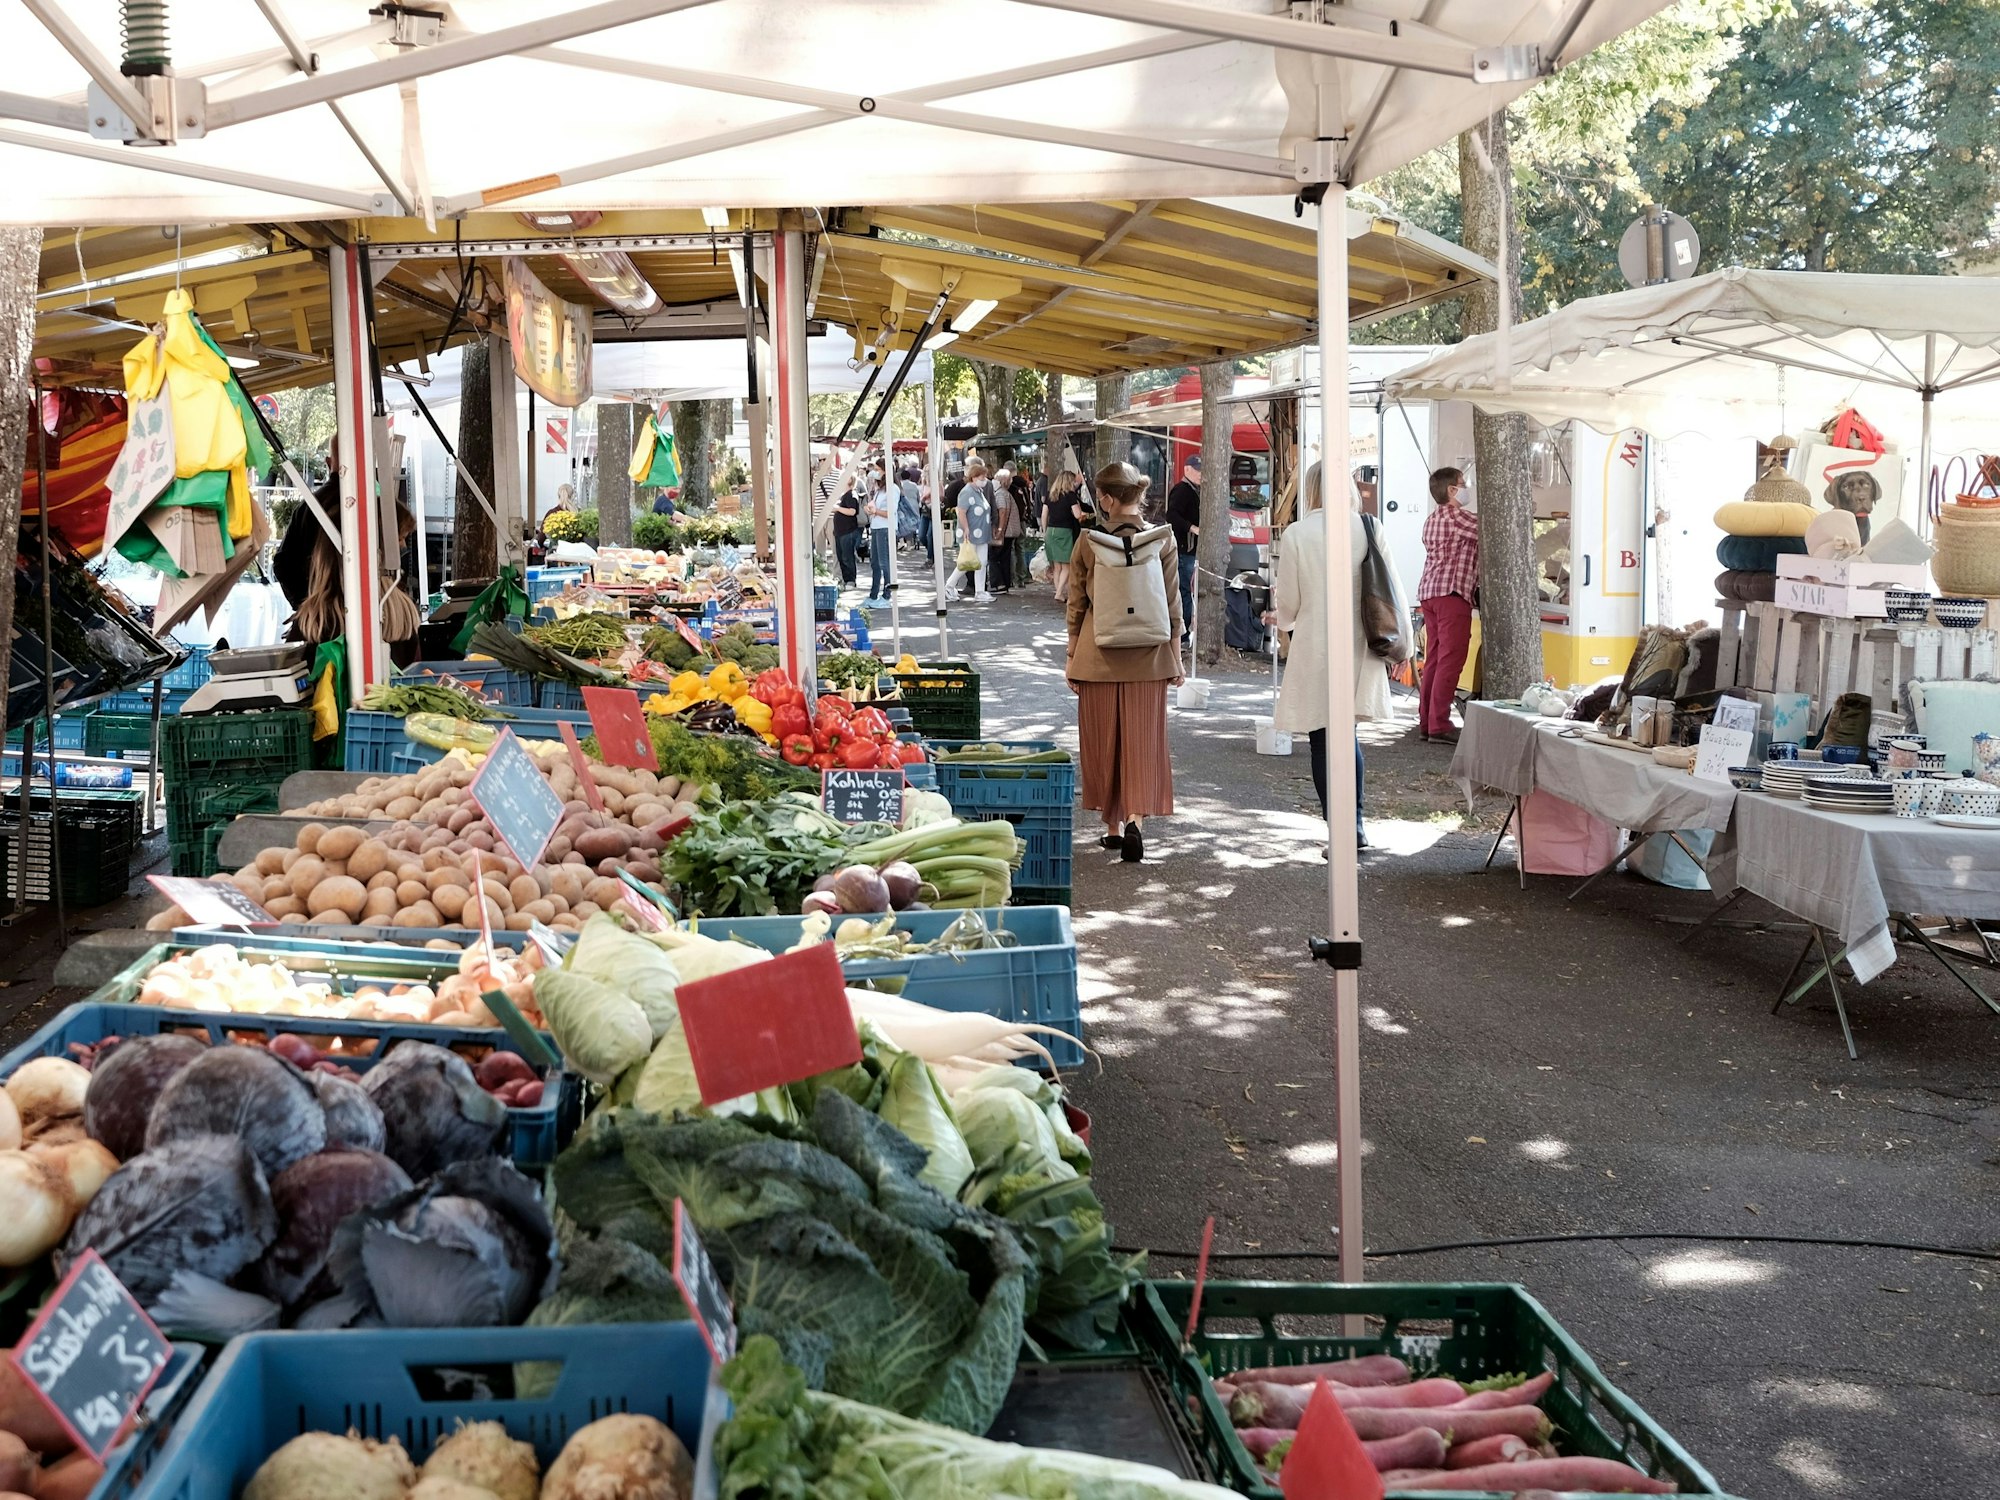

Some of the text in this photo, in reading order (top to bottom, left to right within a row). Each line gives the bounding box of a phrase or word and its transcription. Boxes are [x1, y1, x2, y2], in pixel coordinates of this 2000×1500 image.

[828, 770, 891, 789] Kohlrabi
[826, 789, 834, 799] 1
[826, 800, 836, 809] 2
